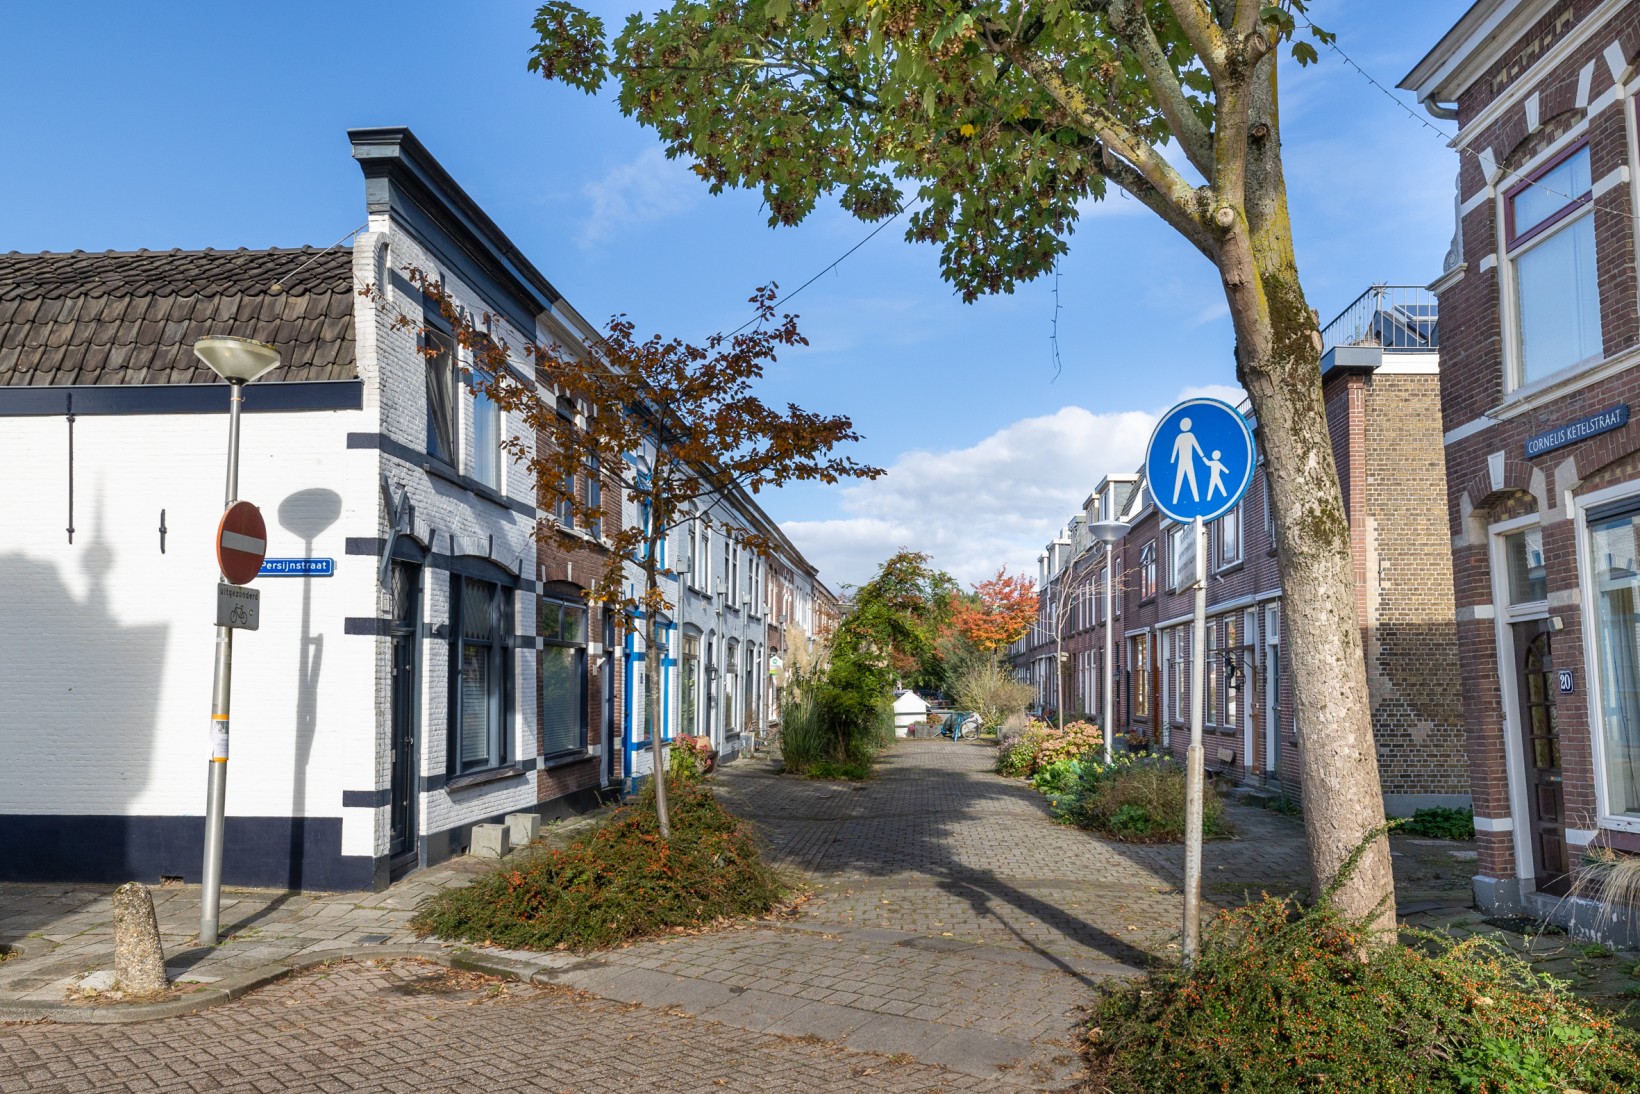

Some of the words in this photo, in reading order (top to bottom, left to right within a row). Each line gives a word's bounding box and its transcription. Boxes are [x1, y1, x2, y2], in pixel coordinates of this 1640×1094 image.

[1528, 430, 1565, 453] CORNELIS
[1567, 410, 1620, 440] KETELSTRAAT
[220, 588, 258, 600] uitgezonderd
[1560, 674, 1570, 690] 20
